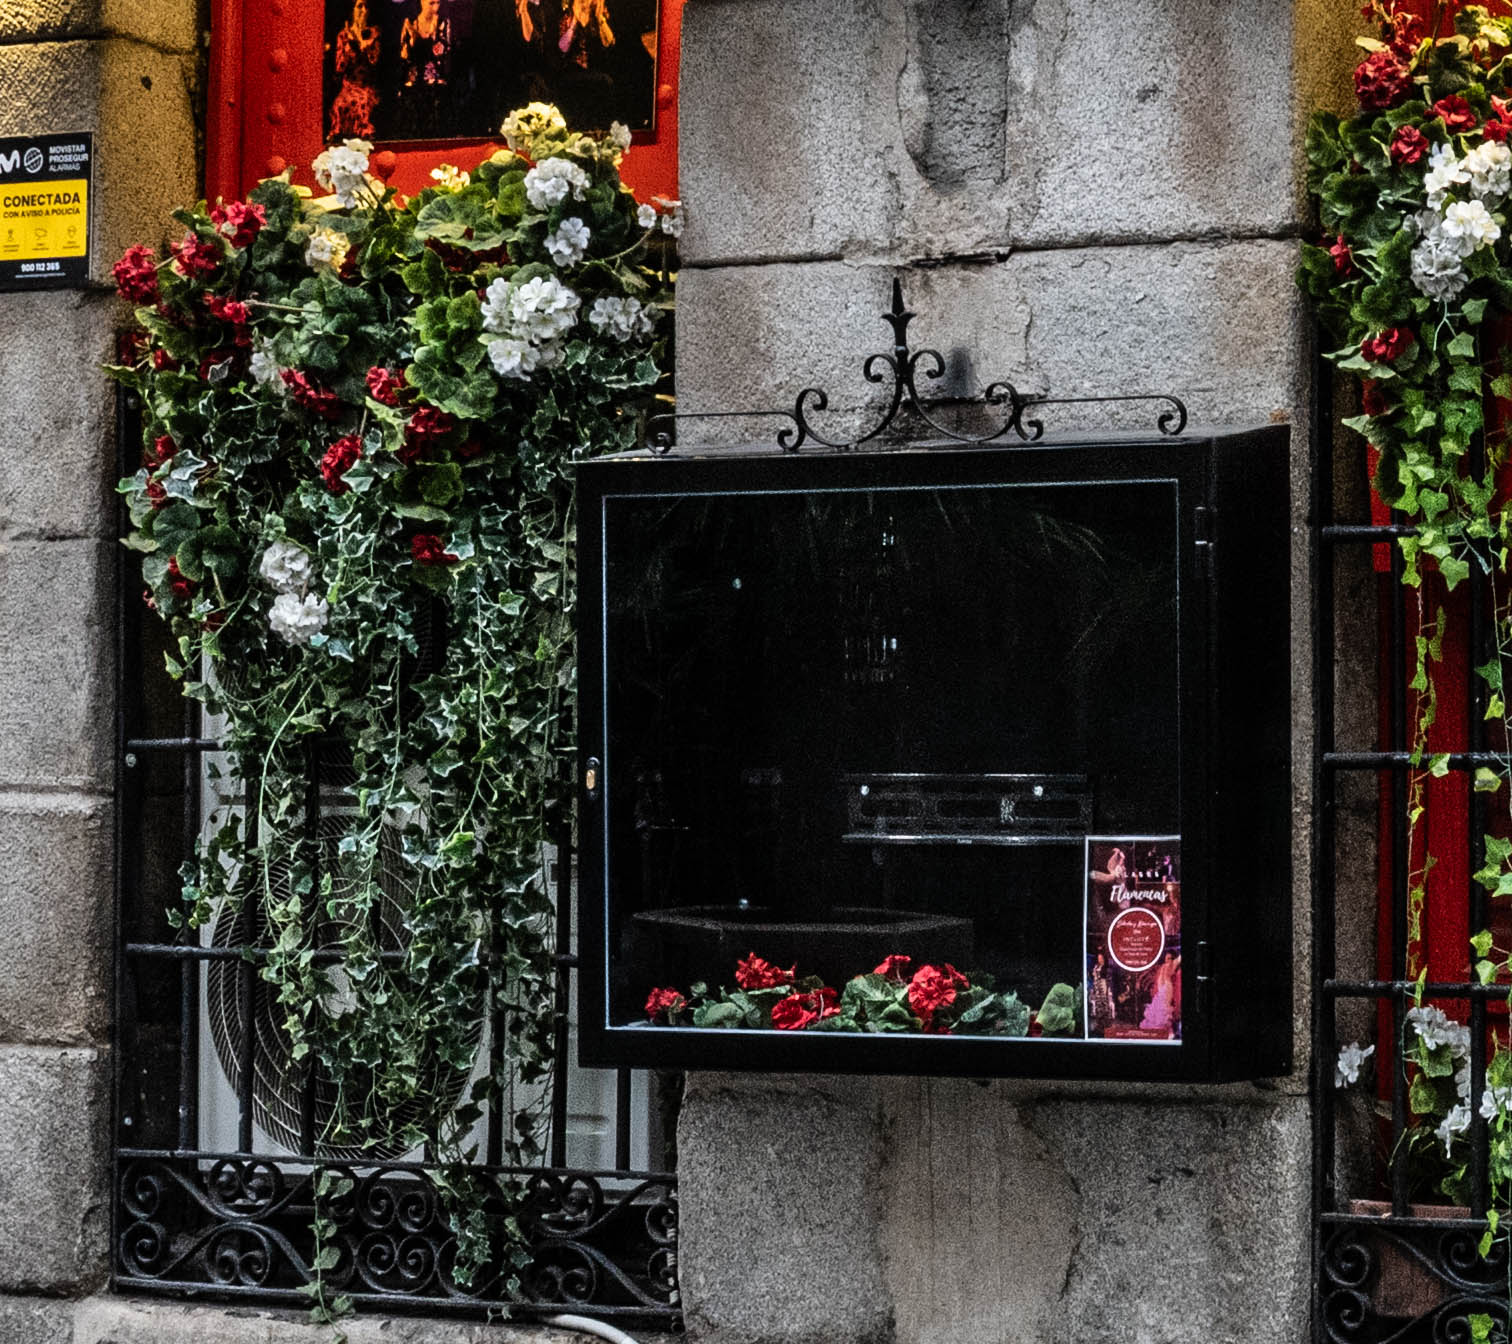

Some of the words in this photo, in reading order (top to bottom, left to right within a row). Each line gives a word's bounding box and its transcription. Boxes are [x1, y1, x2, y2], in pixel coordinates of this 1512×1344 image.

[49, 144, 86, 154] MOVISTAR
[48, 153, 89, 163] PROSEGUR
[48, 162, 81, 172] ALARMAS
[3, 192, 80, 208] CONECTADA
[20, 263, 35, 272] 900
